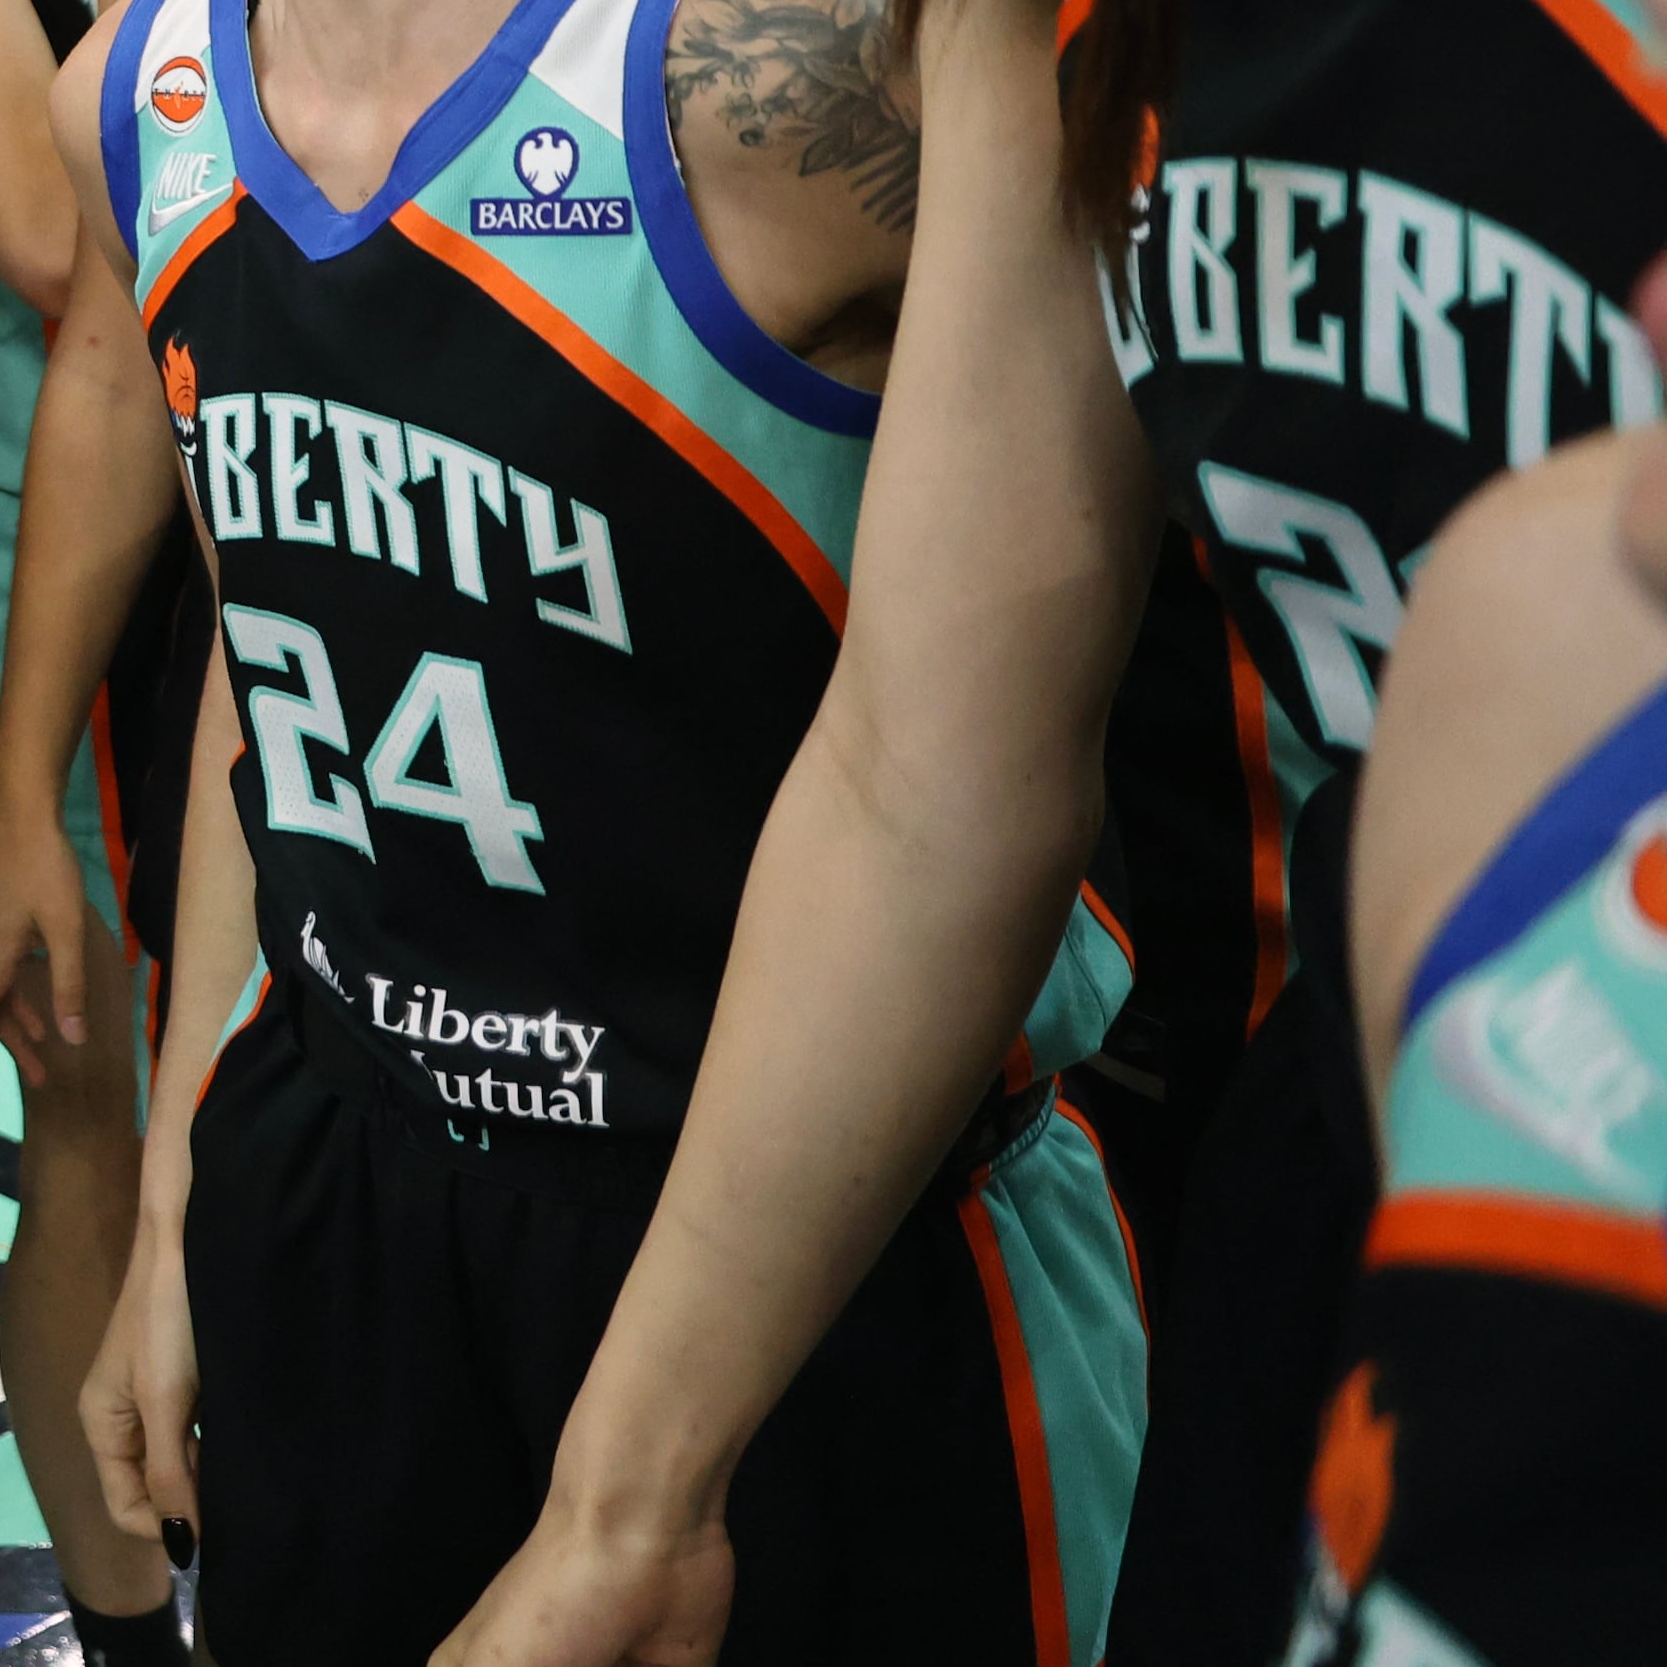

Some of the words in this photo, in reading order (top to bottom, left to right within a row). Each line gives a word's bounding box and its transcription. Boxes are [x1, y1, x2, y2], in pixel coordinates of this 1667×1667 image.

[155, 151, 218, 200] NIKE
[477, 201, 626, 231] BARCLAYS
[1197, 460, 1435, 754] 2
[223, 602, 547, 896] 24
[365, 973, 606, 1084] Liberty
[409, 1048, 611, 1128] utual
